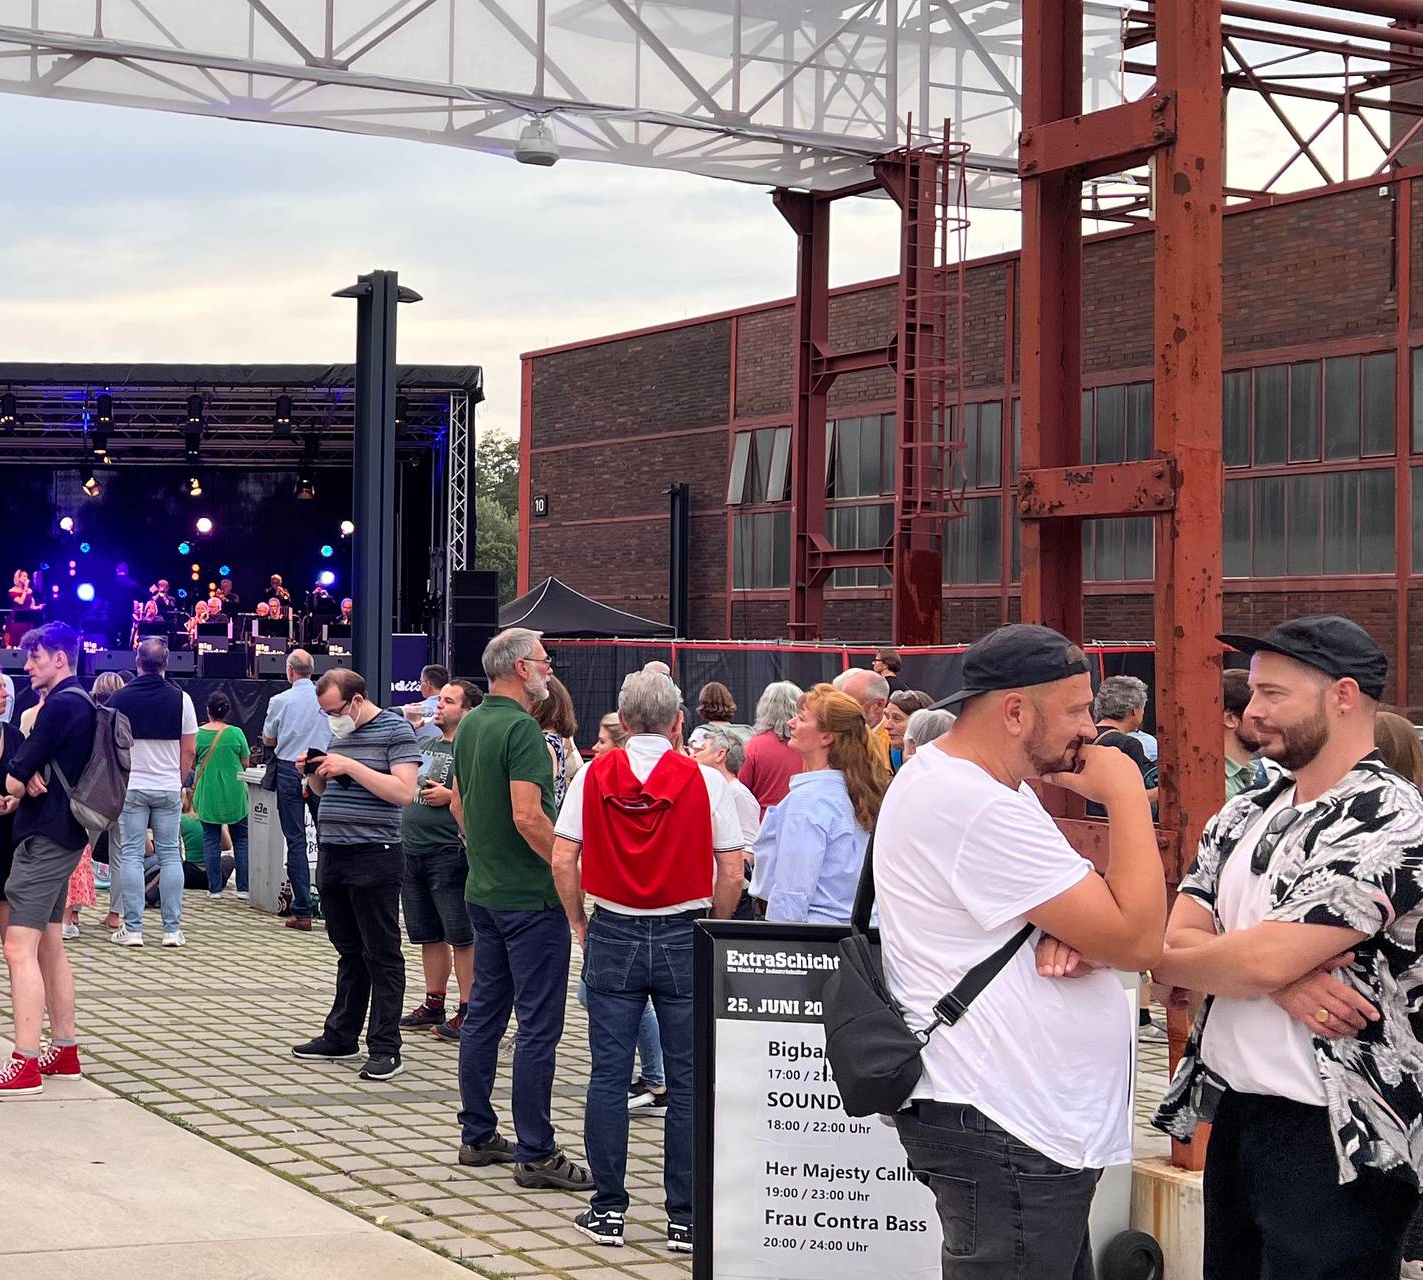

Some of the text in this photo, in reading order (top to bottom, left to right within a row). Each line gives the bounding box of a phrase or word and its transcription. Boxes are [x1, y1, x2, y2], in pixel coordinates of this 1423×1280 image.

[535, 499, 544, 512] 10
[726, 949, 841, 970] ExtraSchicht
[727, 997, 753, 1012] 25.
[757, 999, 800, 1015] JUNI
[768, 1069, 801, 1080] 17:00
[803, 1071, 810, 1082] /
[767, 1091, 841, 1110] SOUND
[767, 1119, 871, 1134] 18:00 / 22:00 Uhr
[766, 1161, 798, 1177] Her
[803, 1163, 870, 1184] Majesty
[765, 1187, 870, 1201] 19:00 / 23:00 Uhr
[765, 1209, 927, 1232] Frau Contra Bass
[763, 1236, 869, 1252] 20:00 / 24:00 Uhr
